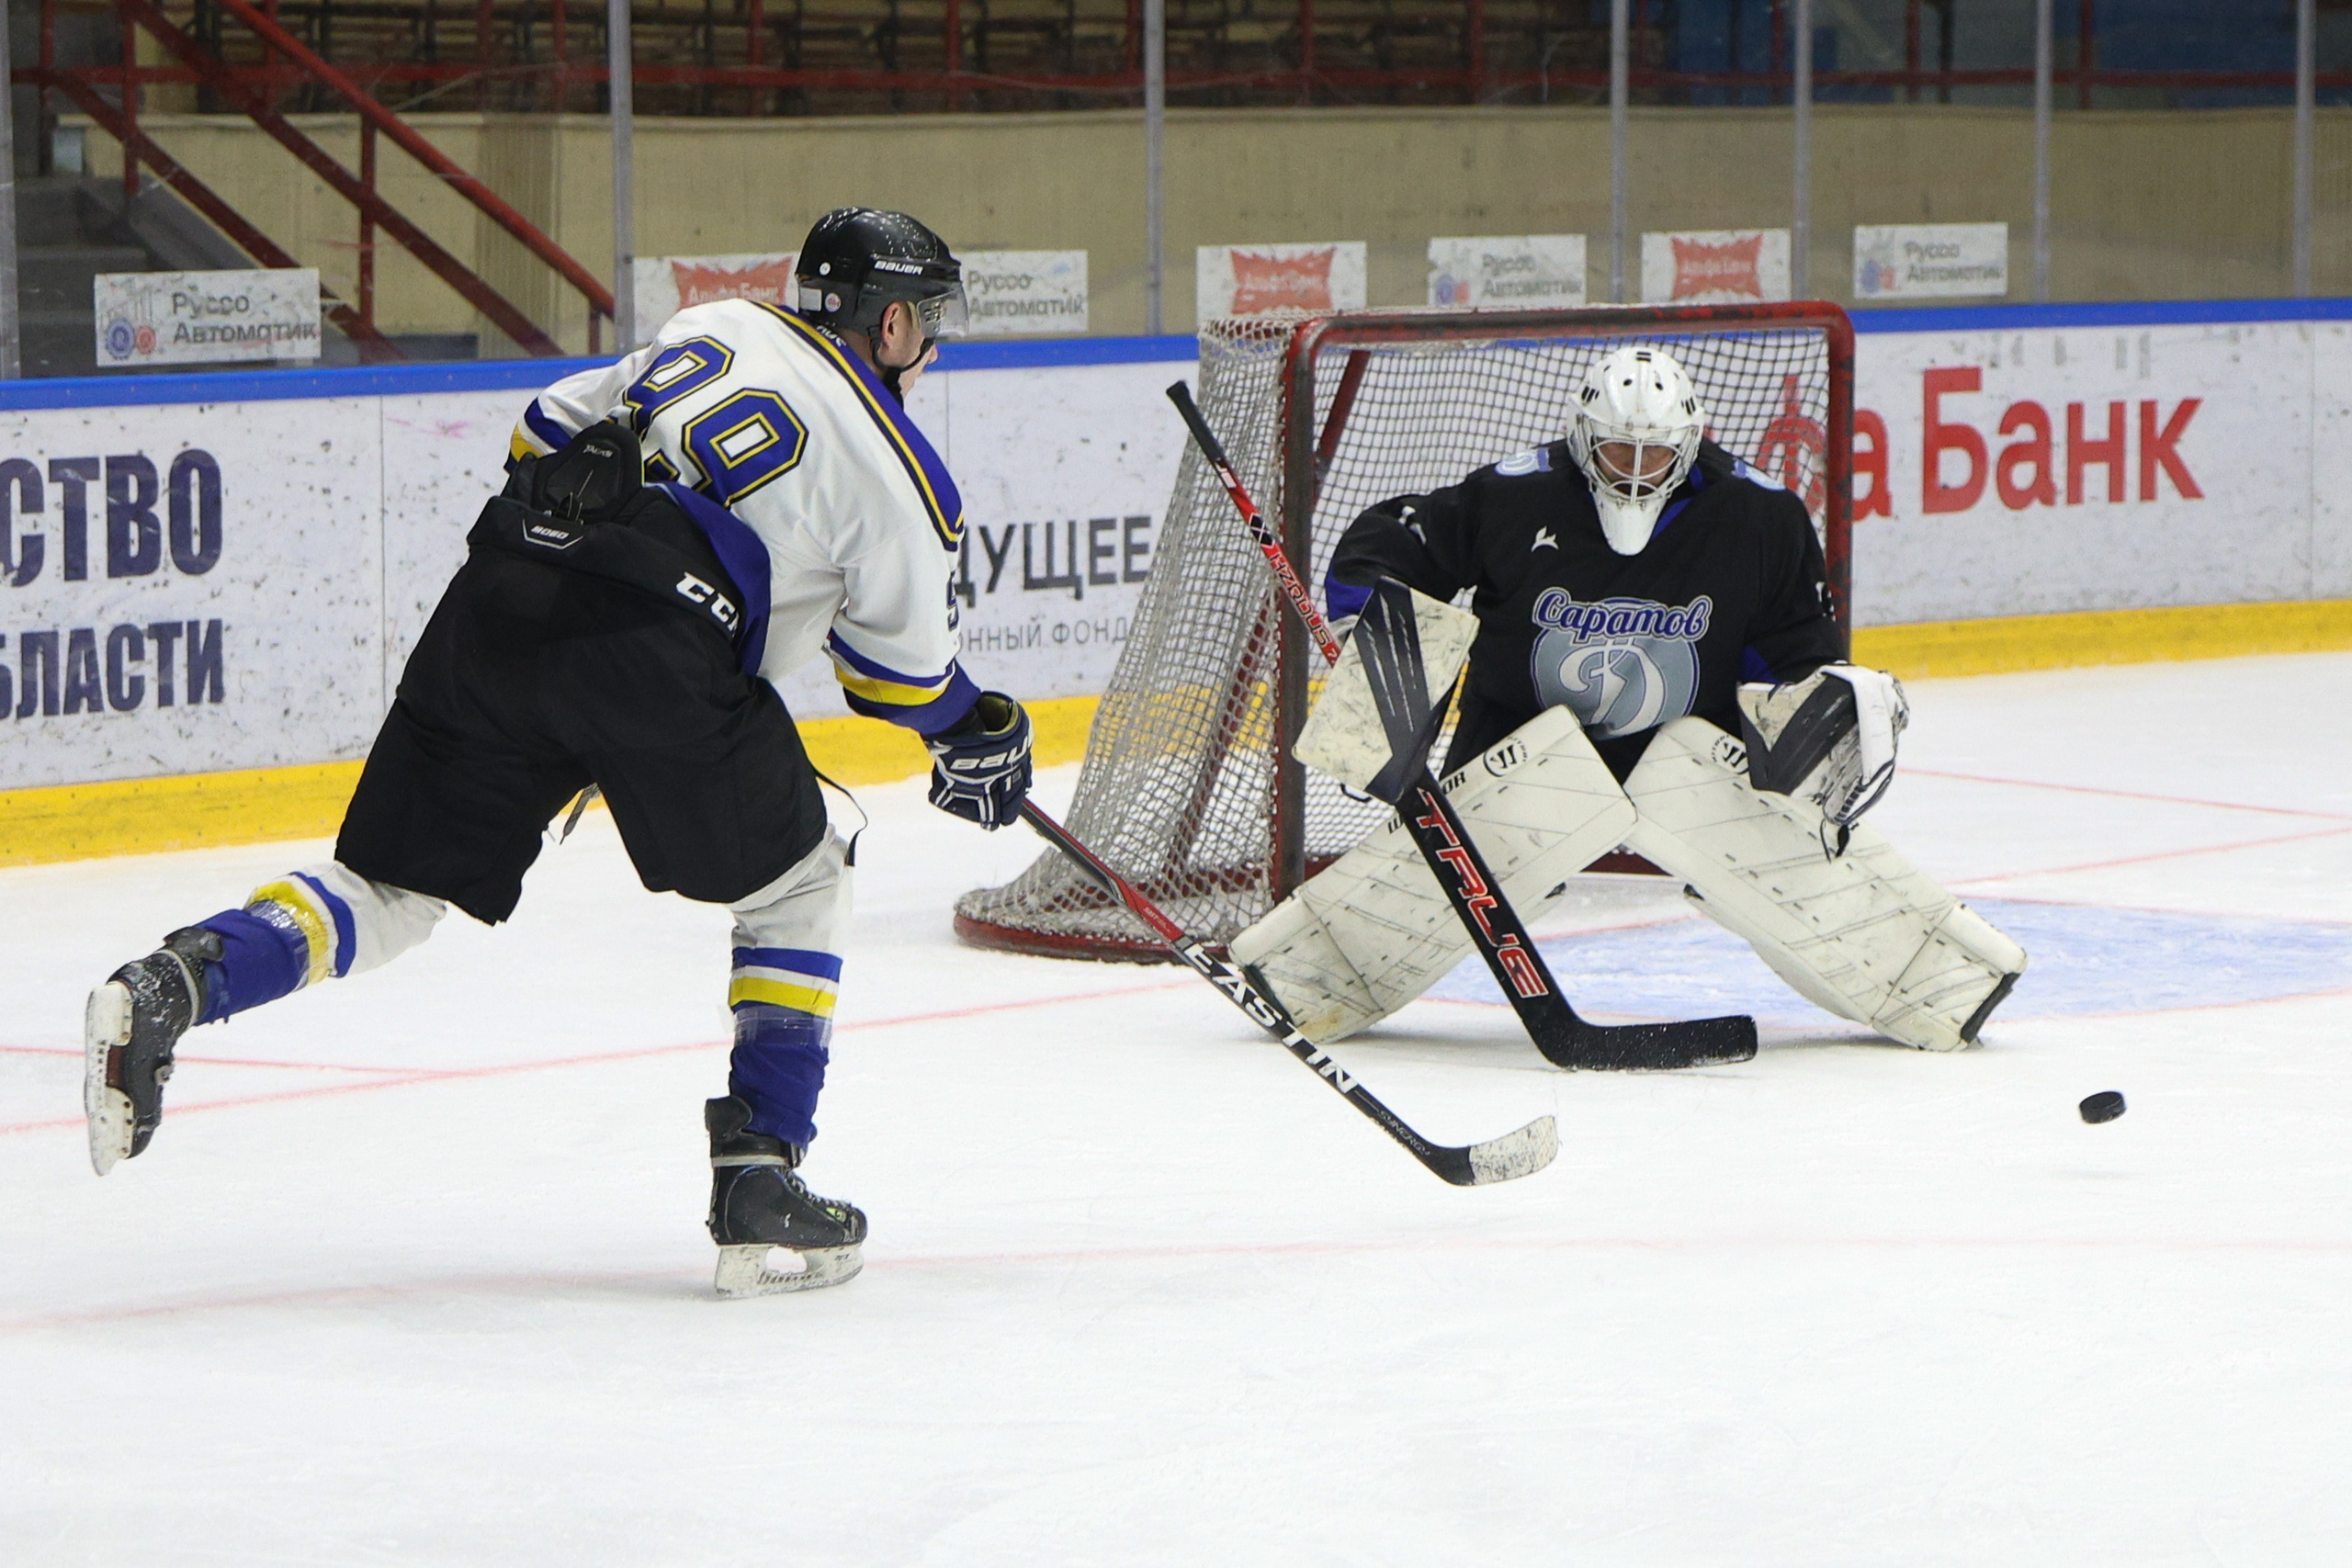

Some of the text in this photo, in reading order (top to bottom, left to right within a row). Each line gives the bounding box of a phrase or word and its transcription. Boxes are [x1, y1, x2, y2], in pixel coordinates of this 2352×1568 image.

[874, 260, 924, 276] BAUER
[967, 271, 1031, 292] Руссо
[1922, 366, 2205, 515] Банк
[0, 448, 223, 588] СТВО
[958, 615, 1129, 653] ННЫЙ ФОНД
[1533, 587, 1713, 647] Саратов
[1416, 787, 1550, 999] TRUE
